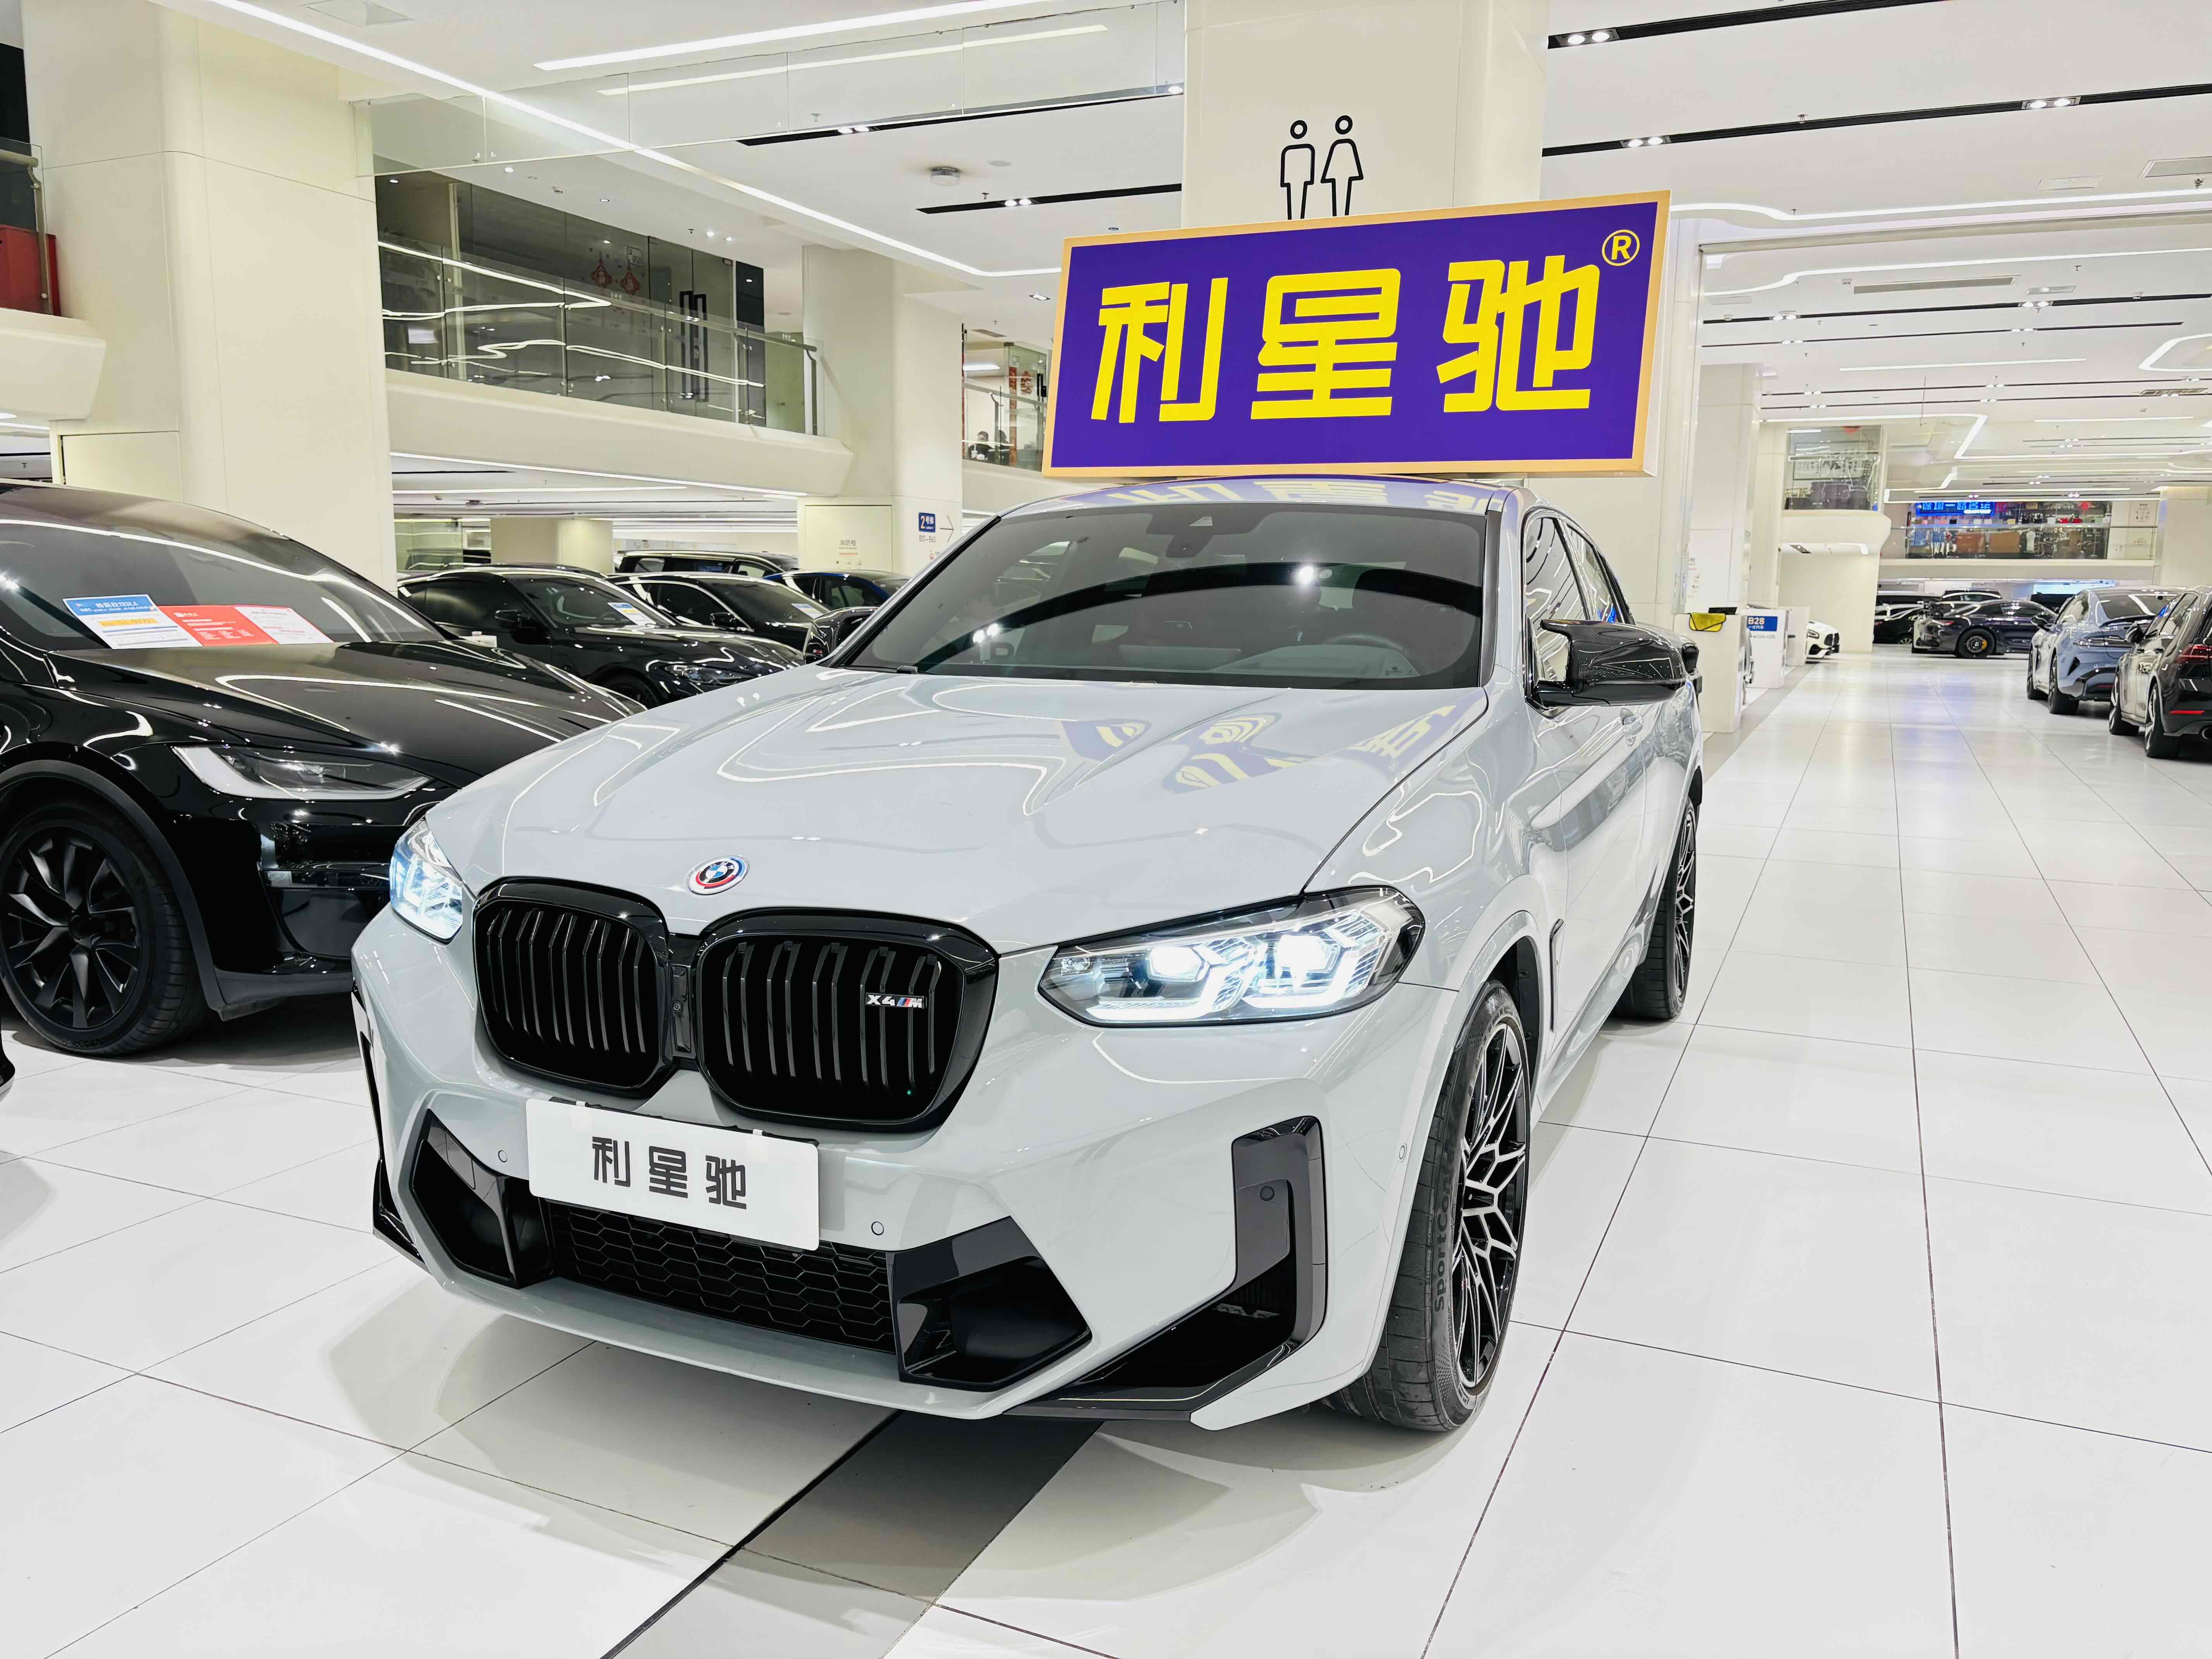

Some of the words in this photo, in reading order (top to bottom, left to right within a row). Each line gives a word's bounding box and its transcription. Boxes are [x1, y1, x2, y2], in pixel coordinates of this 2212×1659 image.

[1091, 254, 1600, 424] 利星驰
[1748, 617, 1765, 625] B28
[866, 994, 895, 1006] X4
[592, 1136, 747, 1209] 利星驰
